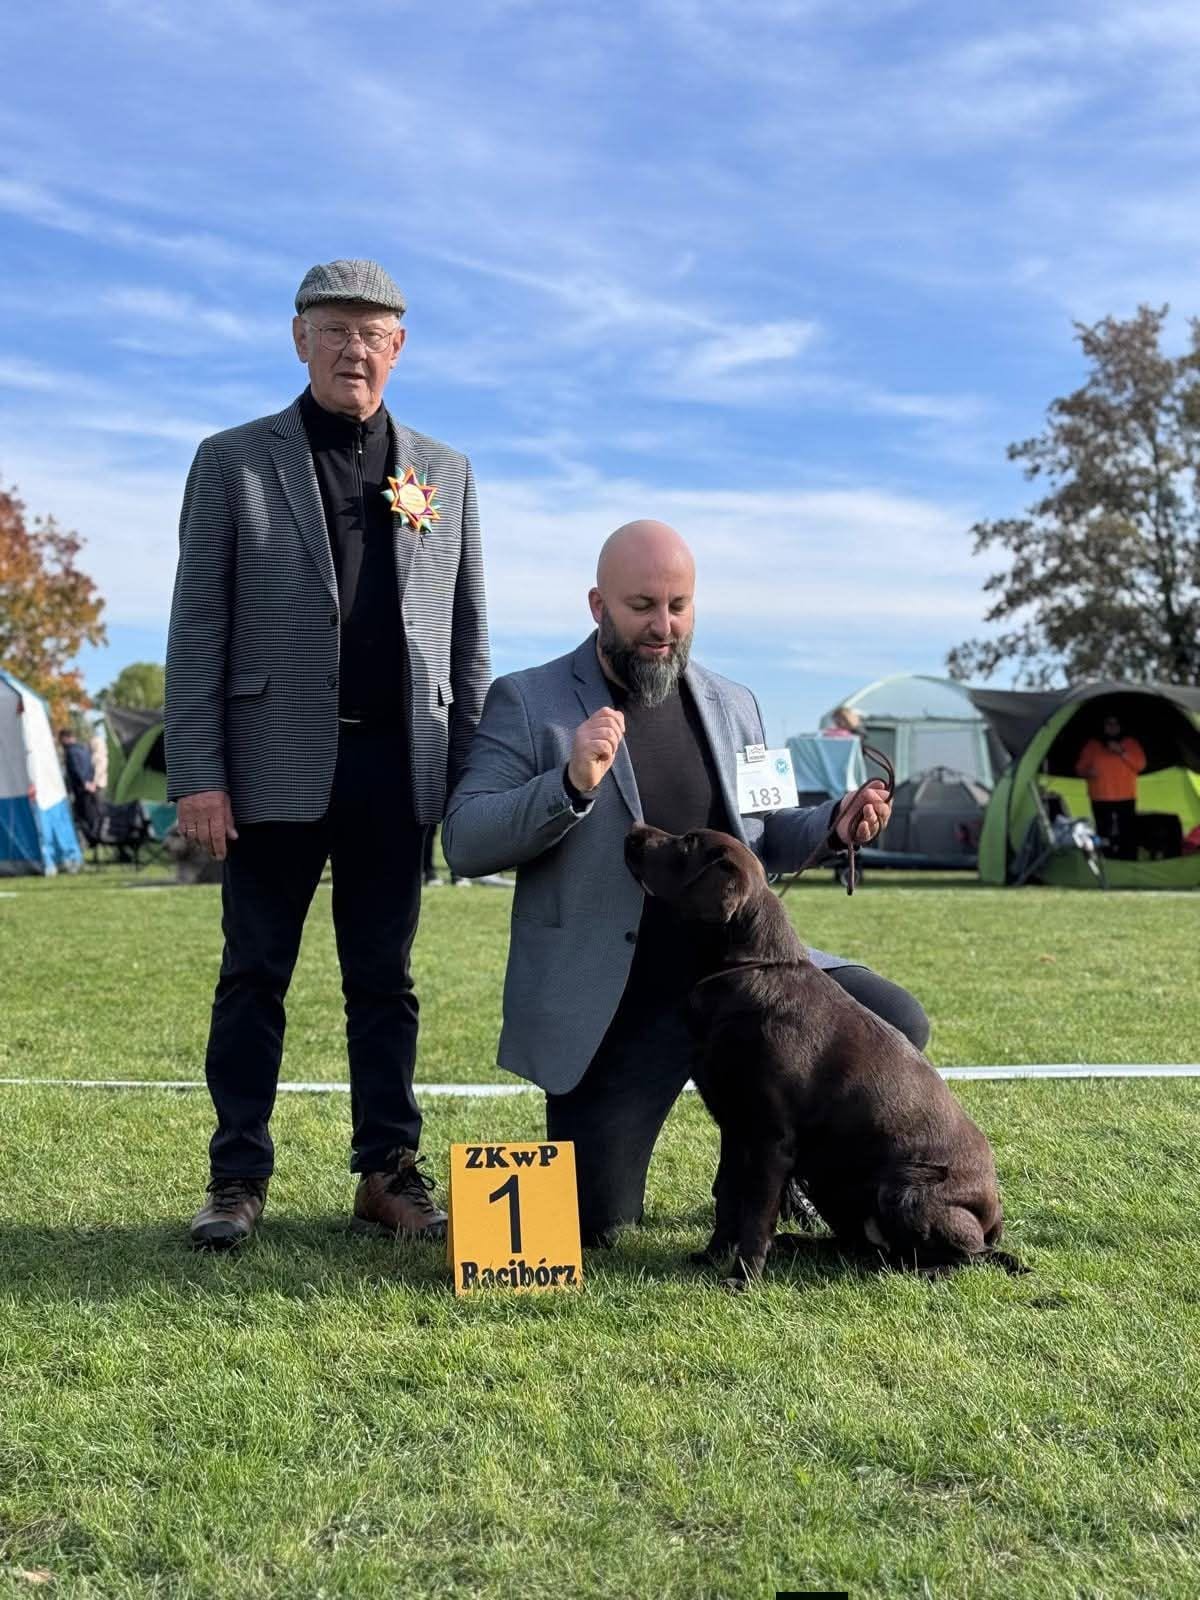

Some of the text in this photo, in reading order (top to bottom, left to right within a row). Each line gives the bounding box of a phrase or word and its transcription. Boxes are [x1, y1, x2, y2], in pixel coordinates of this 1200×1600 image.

[748, 786, 782, 808] 183
[464, 1145, 558, 1169] ZKwP
[489, 1174, 522, 1254] 1
[460, 1257, 578, 1290] Racibórz
